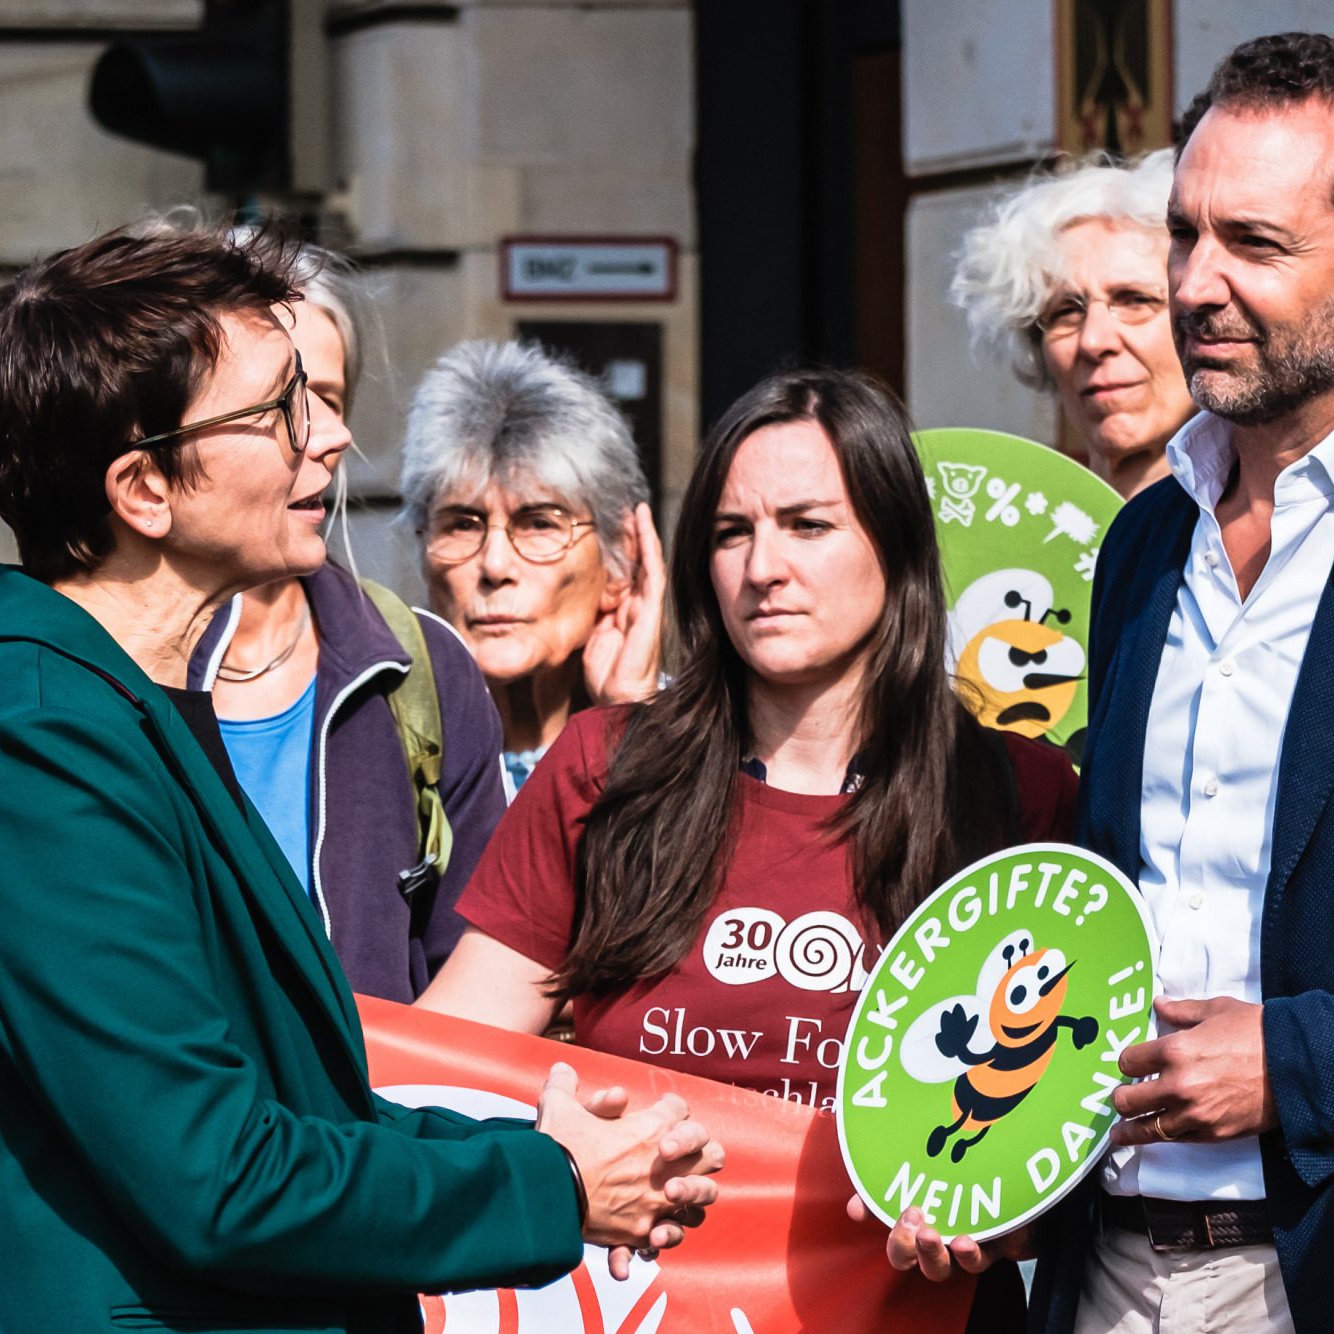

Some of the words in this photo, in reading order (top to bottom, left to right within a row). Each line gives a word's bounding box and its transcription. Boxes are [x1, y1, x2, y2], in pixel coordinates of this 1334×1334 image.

[721, 919, 772, 950] 30
[715, 953, 767, 970] Jahre
[851, 862, 1109, 1108] ACKERGIFTE?
[639, 1007, 763, 1060] Slow
[883, 1160, 1002, 1226] NEIN
[1025, 960, 1145, 1194] DANKE!
